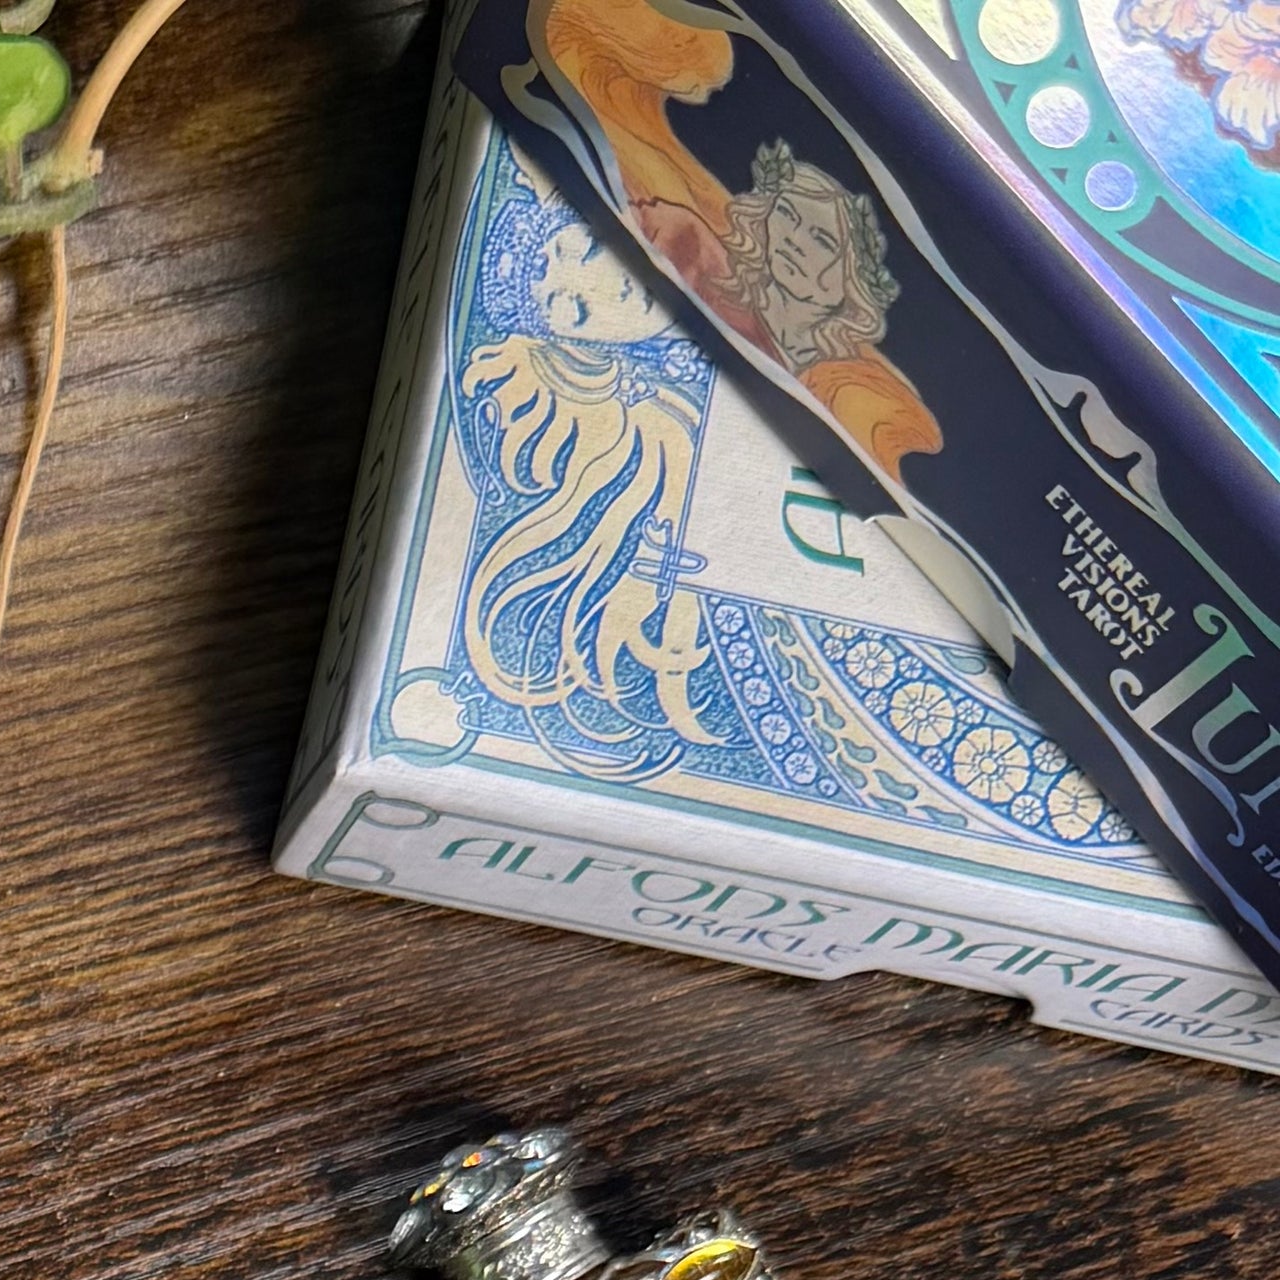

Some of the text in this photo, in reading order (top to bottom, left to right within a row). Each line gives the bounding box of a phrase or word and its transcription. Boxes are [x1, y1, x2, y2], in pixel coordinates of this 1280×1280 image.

[1044, 484, 1176, 631] ETHEREAL
[1057, 567, 1144, 660] TAROT
[1061, 533, 1161, 647] VISIONS
[436, 837, 1187, 1003] ALFONS MARIA
[631, 906, 862, 963] ORACLE
[1091, 998, 1279, 1047] CARDS
